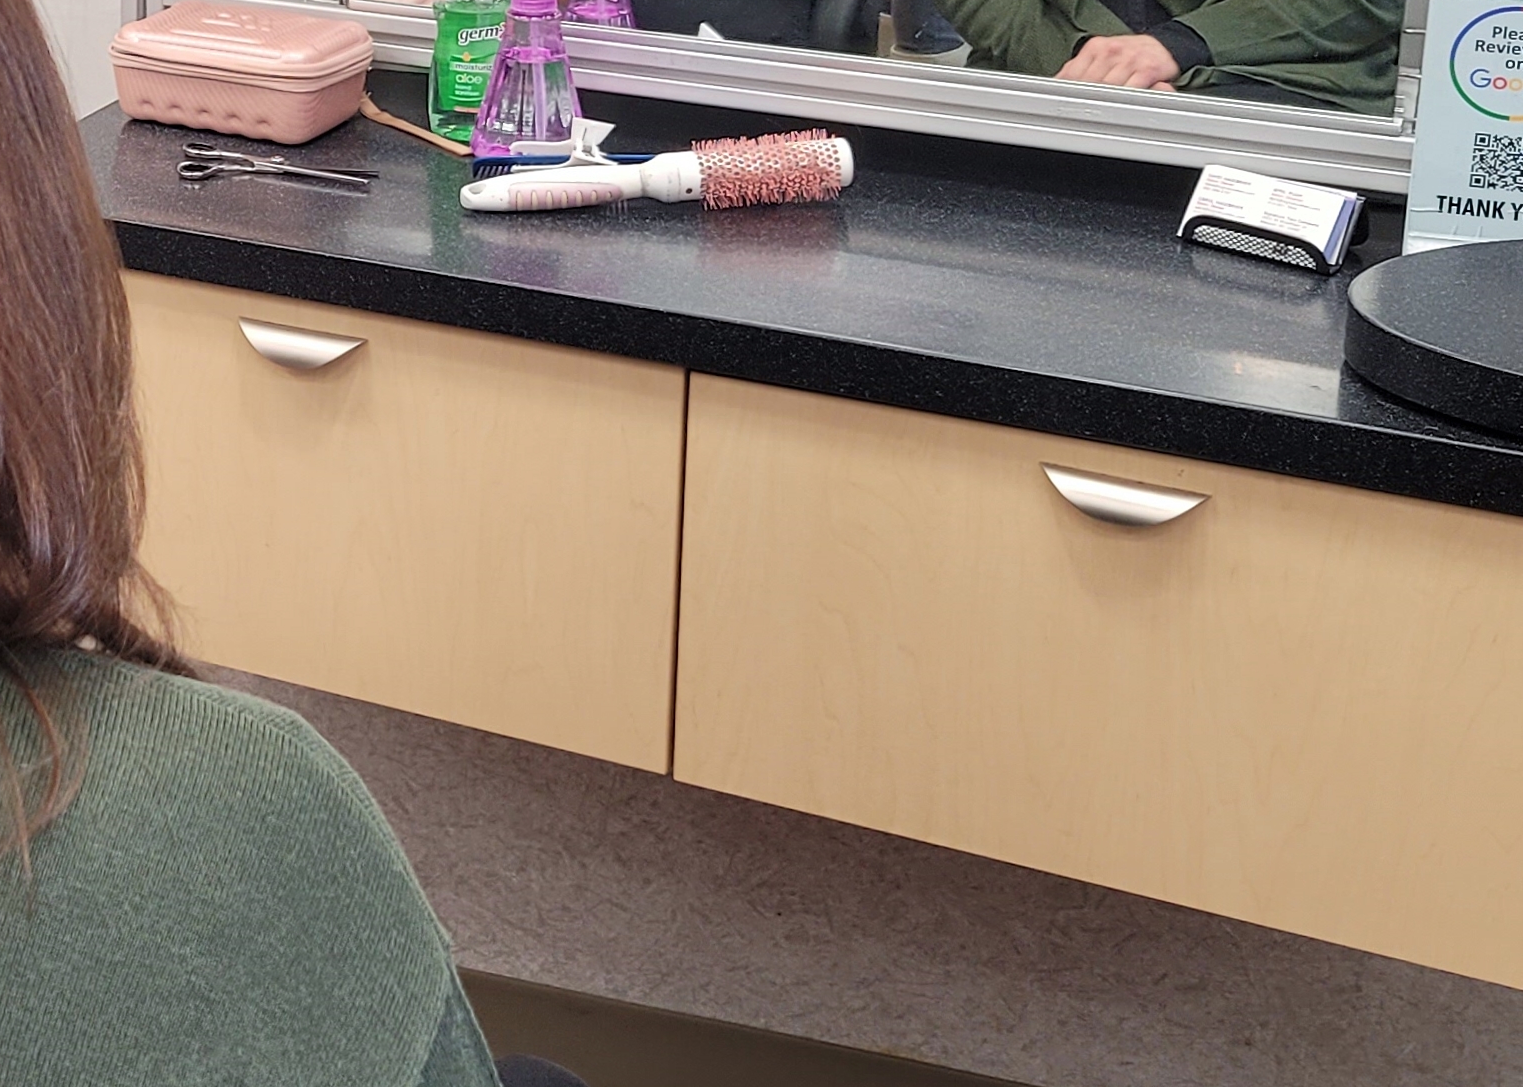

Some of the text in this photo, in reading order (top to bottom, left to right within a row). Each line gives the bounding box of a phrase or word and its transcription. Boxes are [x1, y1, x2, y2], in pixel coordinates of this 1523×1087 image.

[1475, 39, 1523, 55] Revie
[455, 73, 483, 84] aloe
[1436, 195, 1506, 220] THANK
